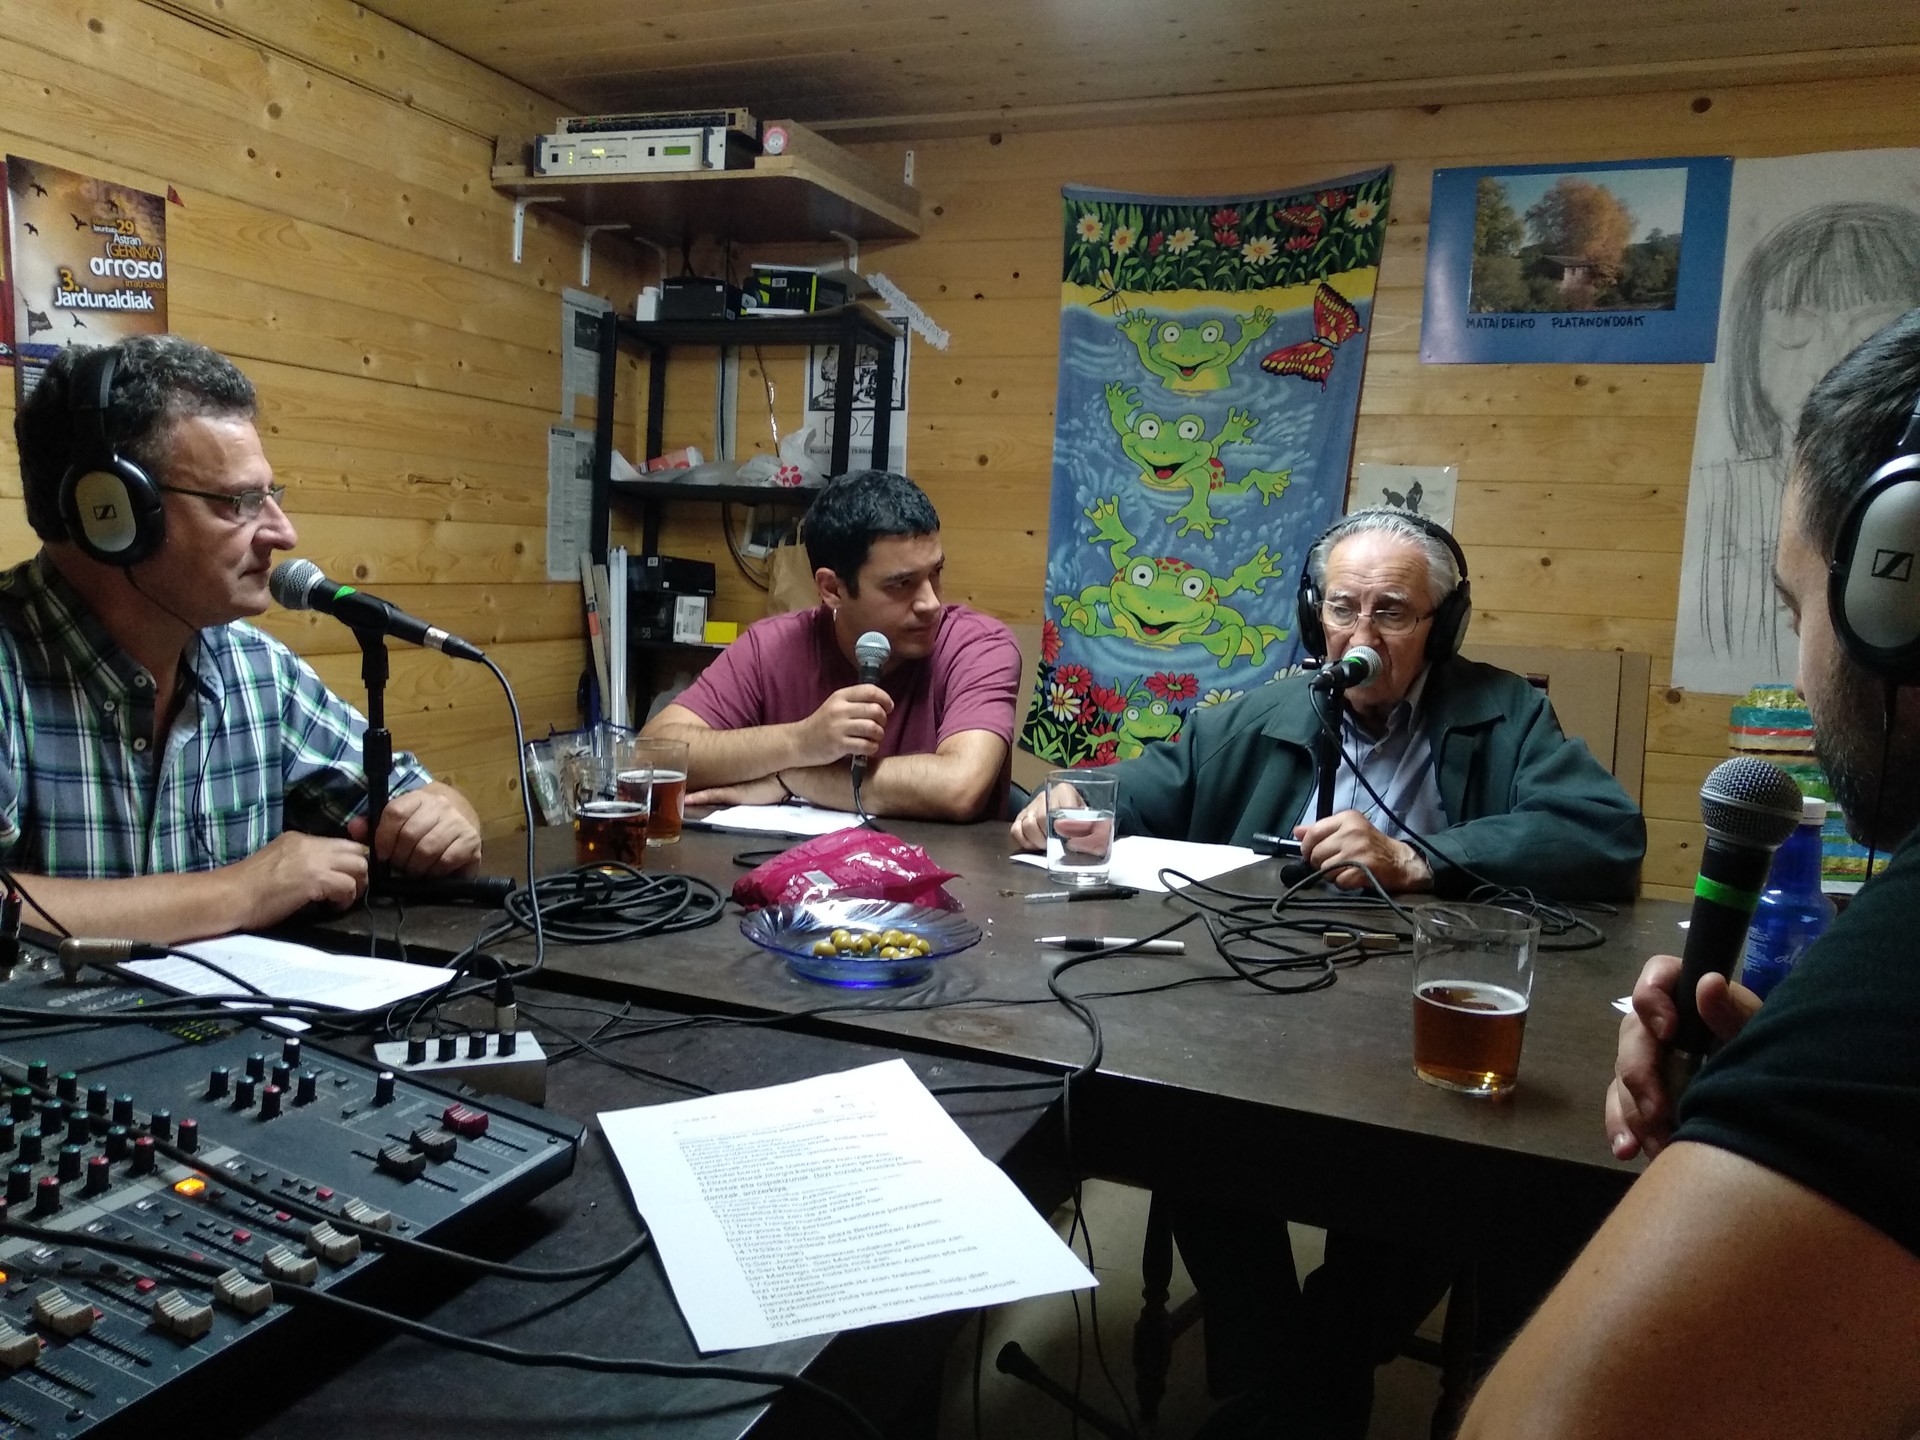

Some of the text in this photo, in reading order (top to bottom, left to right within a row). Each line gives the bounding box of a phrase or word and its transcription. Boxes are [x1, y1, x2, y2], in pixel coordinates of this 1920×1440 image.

[116, 220, 135, 235] 29
[113, 233, 141, 245] Astran
[106, 243, 163, 261] (GERNIKA)
[60, 268, 80, 291] 3.
[55, 287, 154, 309] Jardunaldiak
